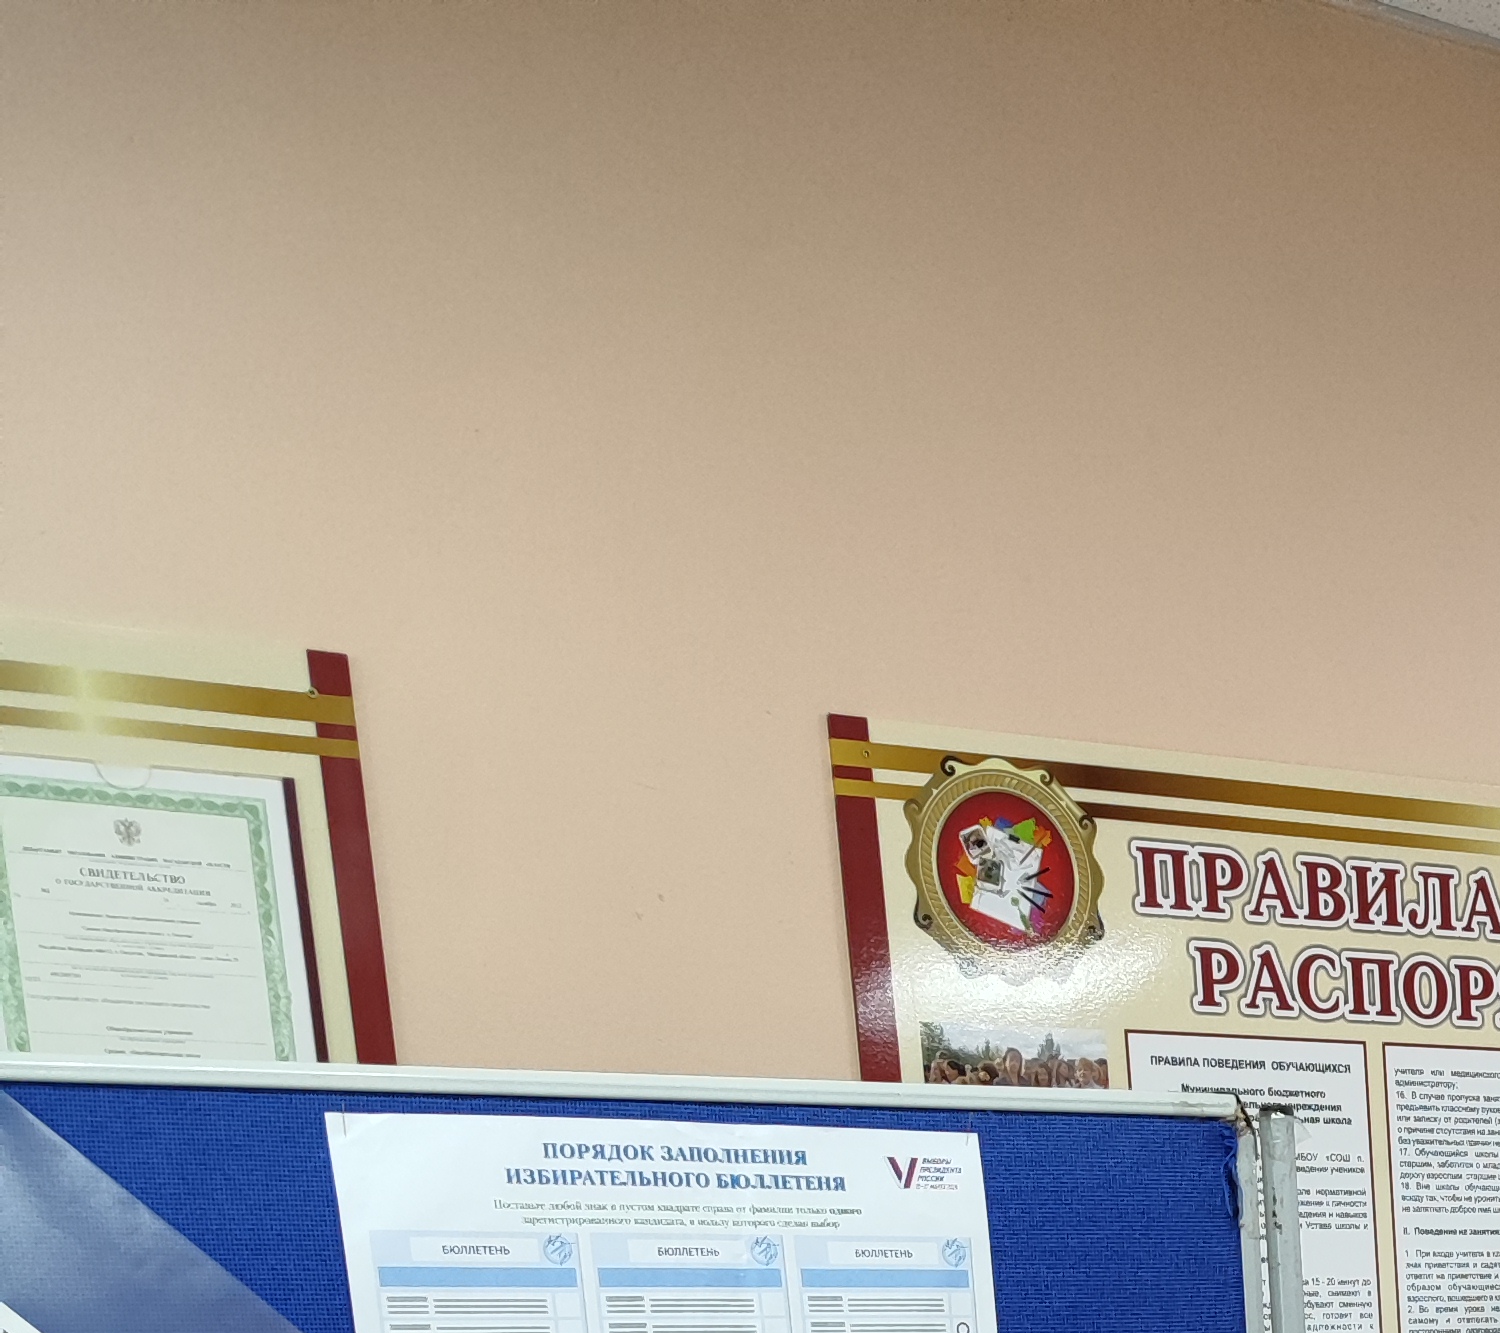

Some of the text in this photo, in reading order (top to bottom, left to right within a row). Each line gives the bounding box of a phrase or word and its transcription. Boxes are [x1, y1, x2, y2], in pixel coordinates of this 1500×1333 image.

[1150, 1055, 1351, 1074] ПРАВИЛА ПОВЕДЕНИЯ ОБУЧАЮЩИХСЯ
[542, 1142, 807, 1165] ПОРЯДОК ЗАПОЛНЕНИЯ
[505, 1168, 846, 1191] ИЗБИРАТЕЛЬНОГО БЮЛЛЕТЕНЯ
[441, 1244, 510, 1255] БЮЛЛЕТЕНЬ
[657, 1246, 719, 1256] БЮЛЛЕТЕНЬ
[854, 1248, 913, 1258] БЮЛЛЕТЕНЬ
[1406, 1282, 1441, 1292] образом
